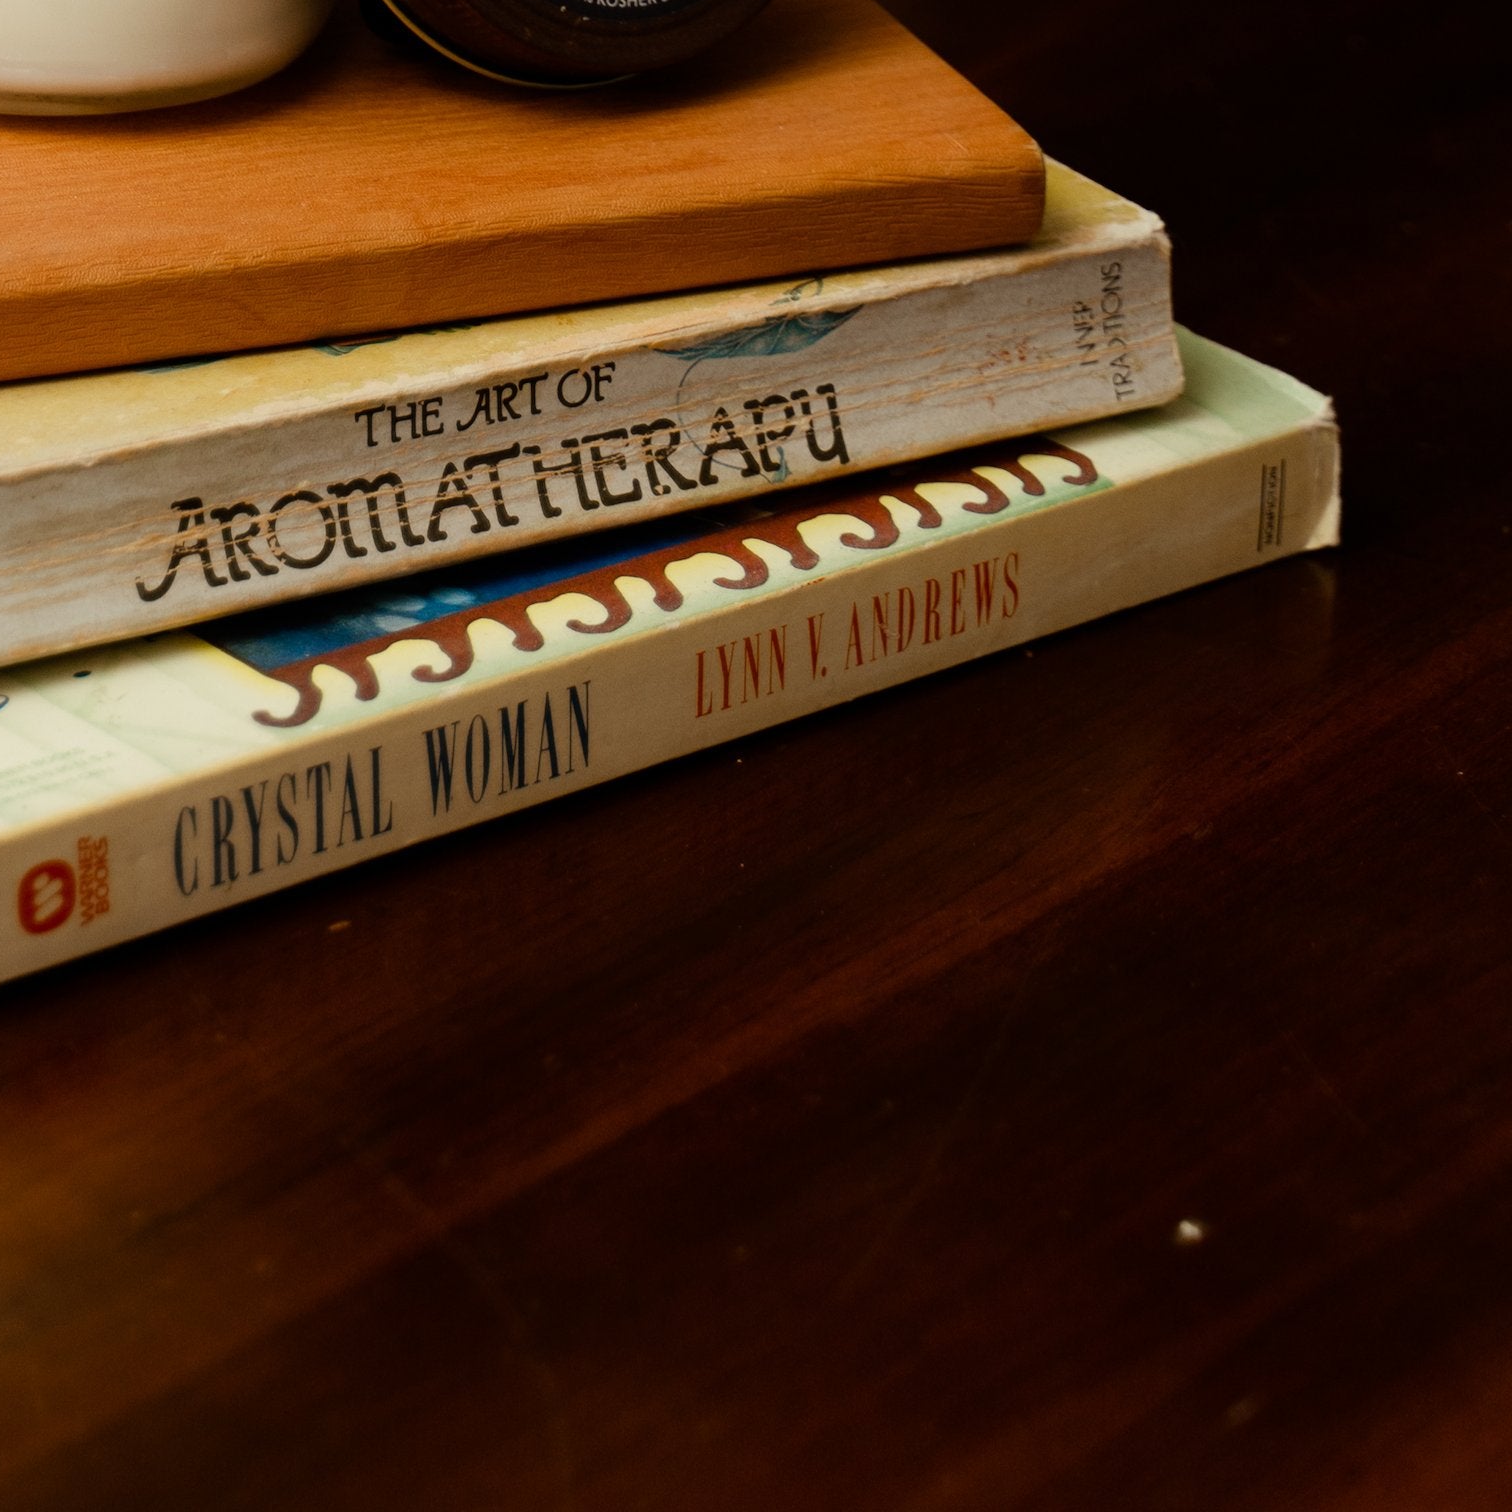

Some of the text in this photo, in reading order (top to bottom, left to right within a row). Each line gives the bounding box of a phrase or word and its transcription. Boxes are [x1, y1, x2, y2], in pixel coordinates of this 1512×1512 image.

[355, 361, 616, 447] THE ART OF
[694, 551, 1023, 720] LYNN V. ANDREWS
[172, 744, 394, 897] CRYSTAL
[422, 680, 595, 817] WOMAN
